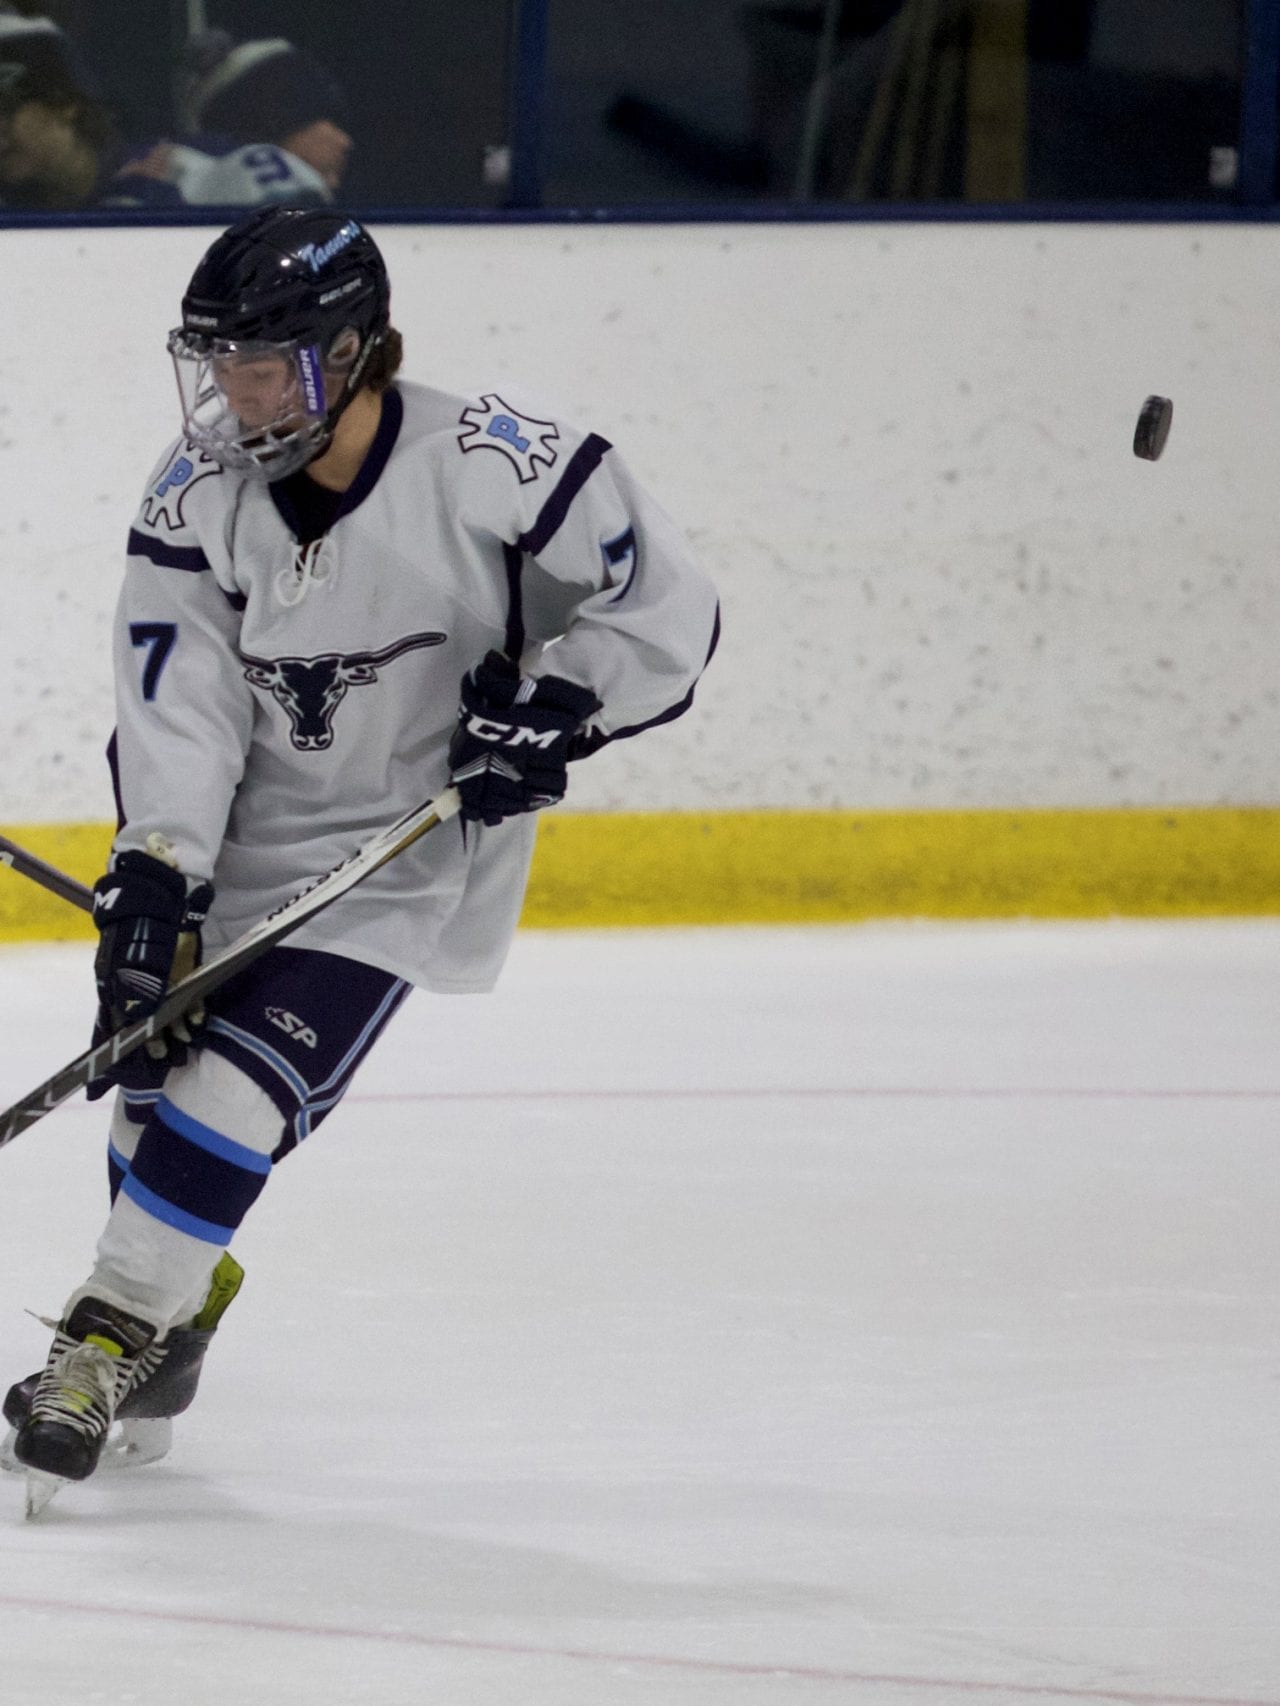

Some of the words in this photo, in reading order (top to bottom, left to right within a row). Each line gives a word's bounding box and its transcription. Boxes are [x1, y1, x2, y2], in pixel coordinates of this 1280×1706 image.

[300, 349, 318, 411] BAUER
[486, 414, 531, 454] P
[155, 456, 194, 498] P
[599, 524, 638, 604] 7
[128, 621, 178, 703] 7
[459, 704, 562, 749] CM
